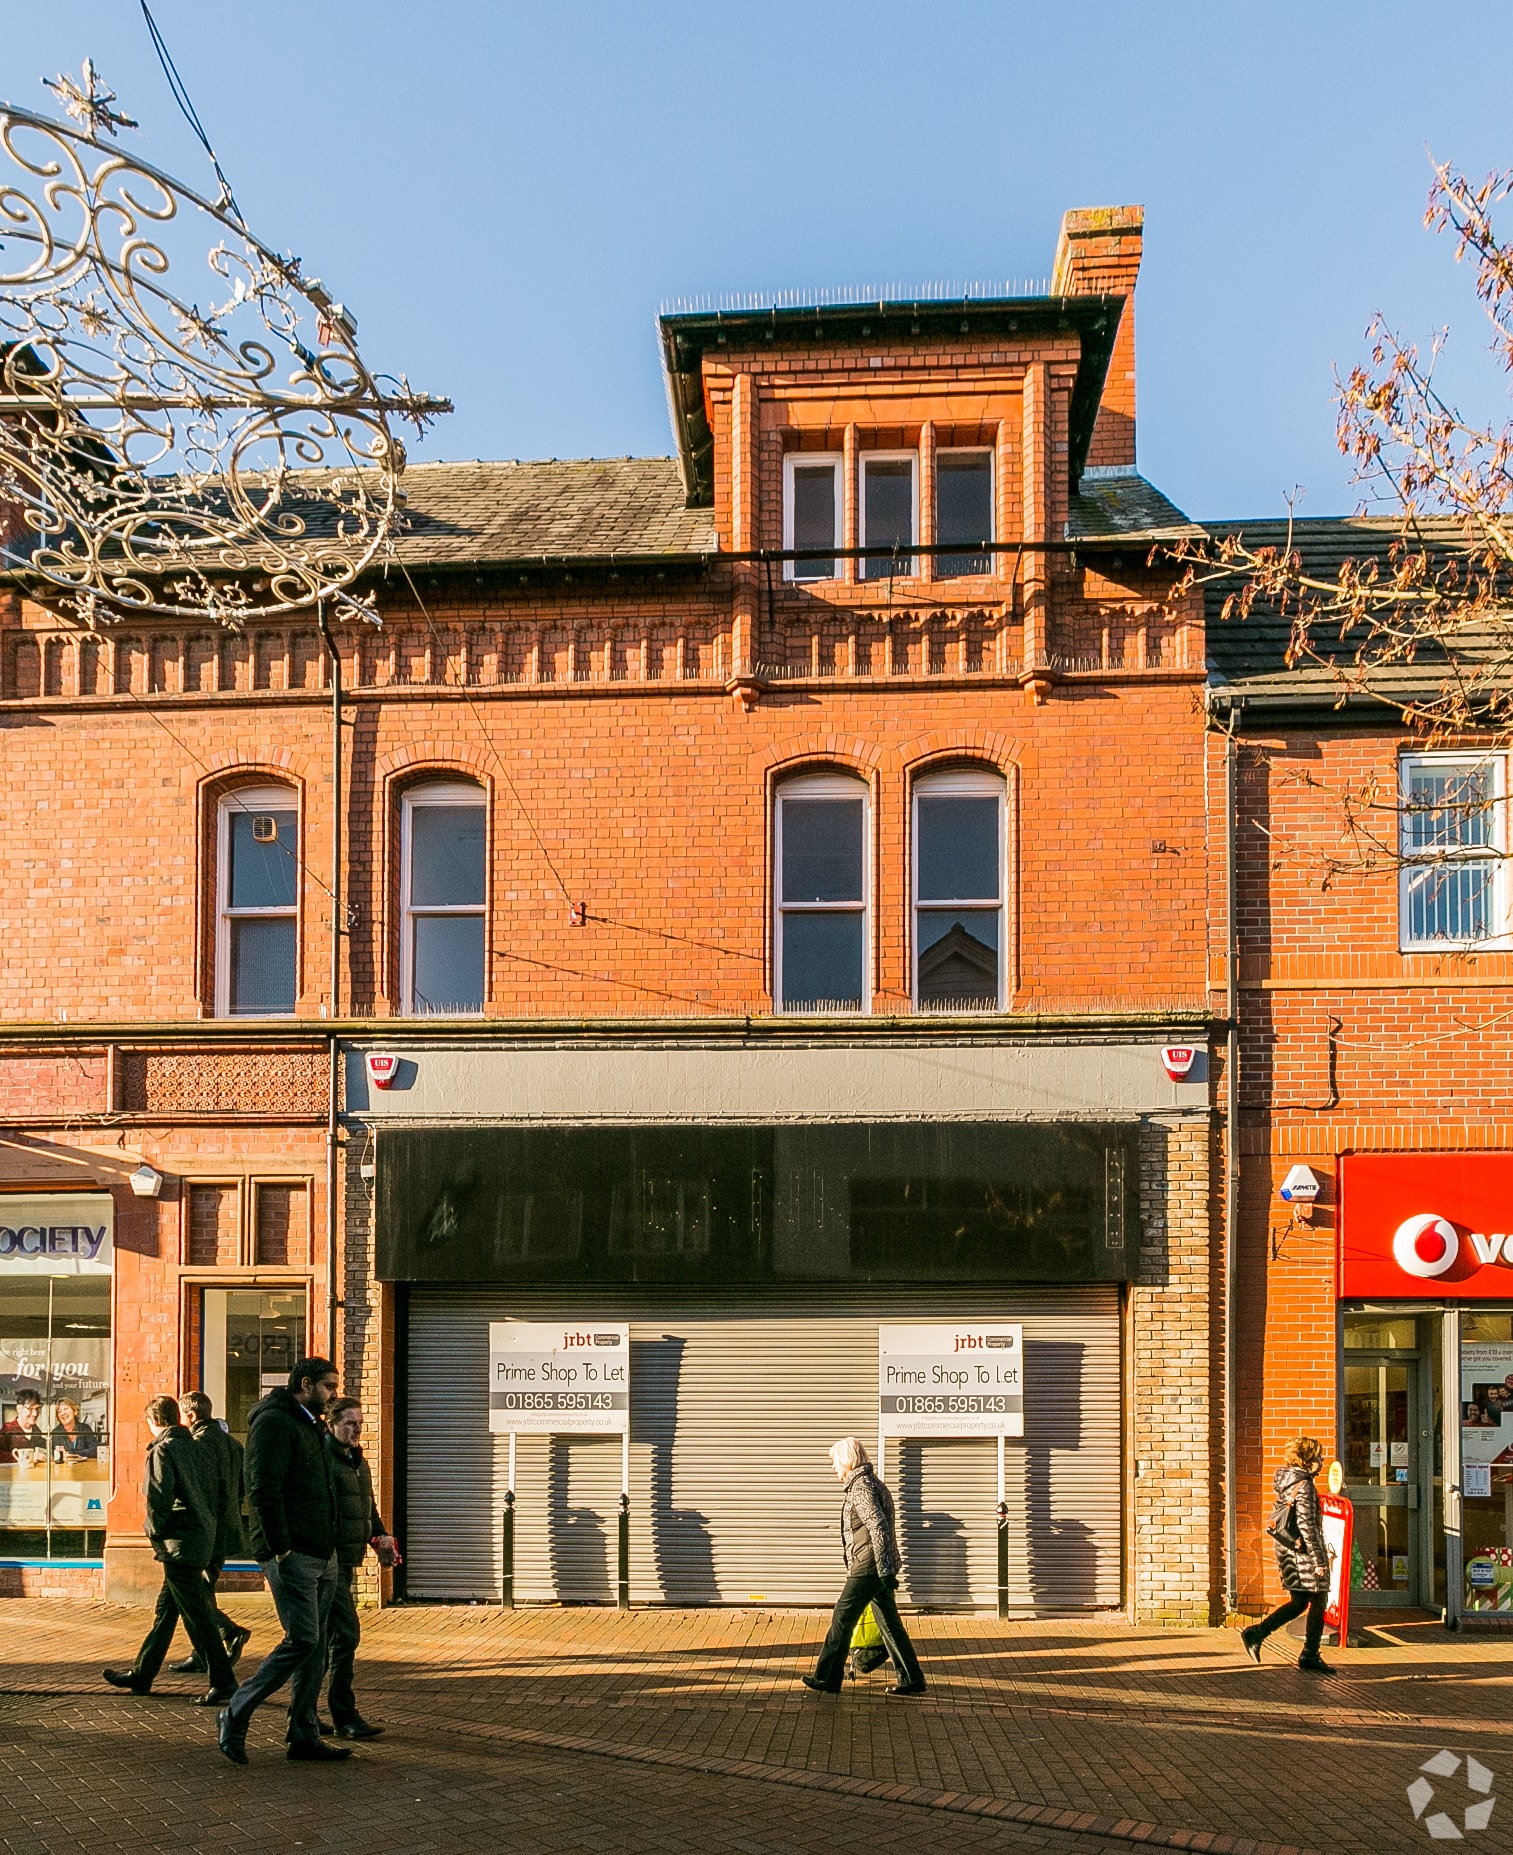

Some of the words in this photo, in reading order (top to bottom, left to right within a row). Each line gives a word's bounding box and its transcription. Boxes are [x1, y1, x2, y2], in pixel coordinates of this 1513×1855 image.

[563, 1332, 592, 1350] jrbt
[954, 1334, 984, 1352] jrbt
[12, 1357, 45, 1381] for
[52, 1362, 89, 1381] you
[497, 1363, 536, 1381] Prime
[541, 1362, 578, 1387] Shop
[583, 1363, 598, 1381] To
[603, 1363, 625, 1381] Let
[887, 1366, 926, 1384] Prime
[932, 1365, 969, 1390] Shop
[974, 1365, 990, 1383] To
[996, 1365, 1018, 1383] Let
[78, 1379, 109, 1389] future
[505, 1393, 553, 1409] 01865
[557, 1393, 613, 1409] 595143
[896, 1396, 945, 1413] 01865
[948, 1396, 1006, 1413] 595143
